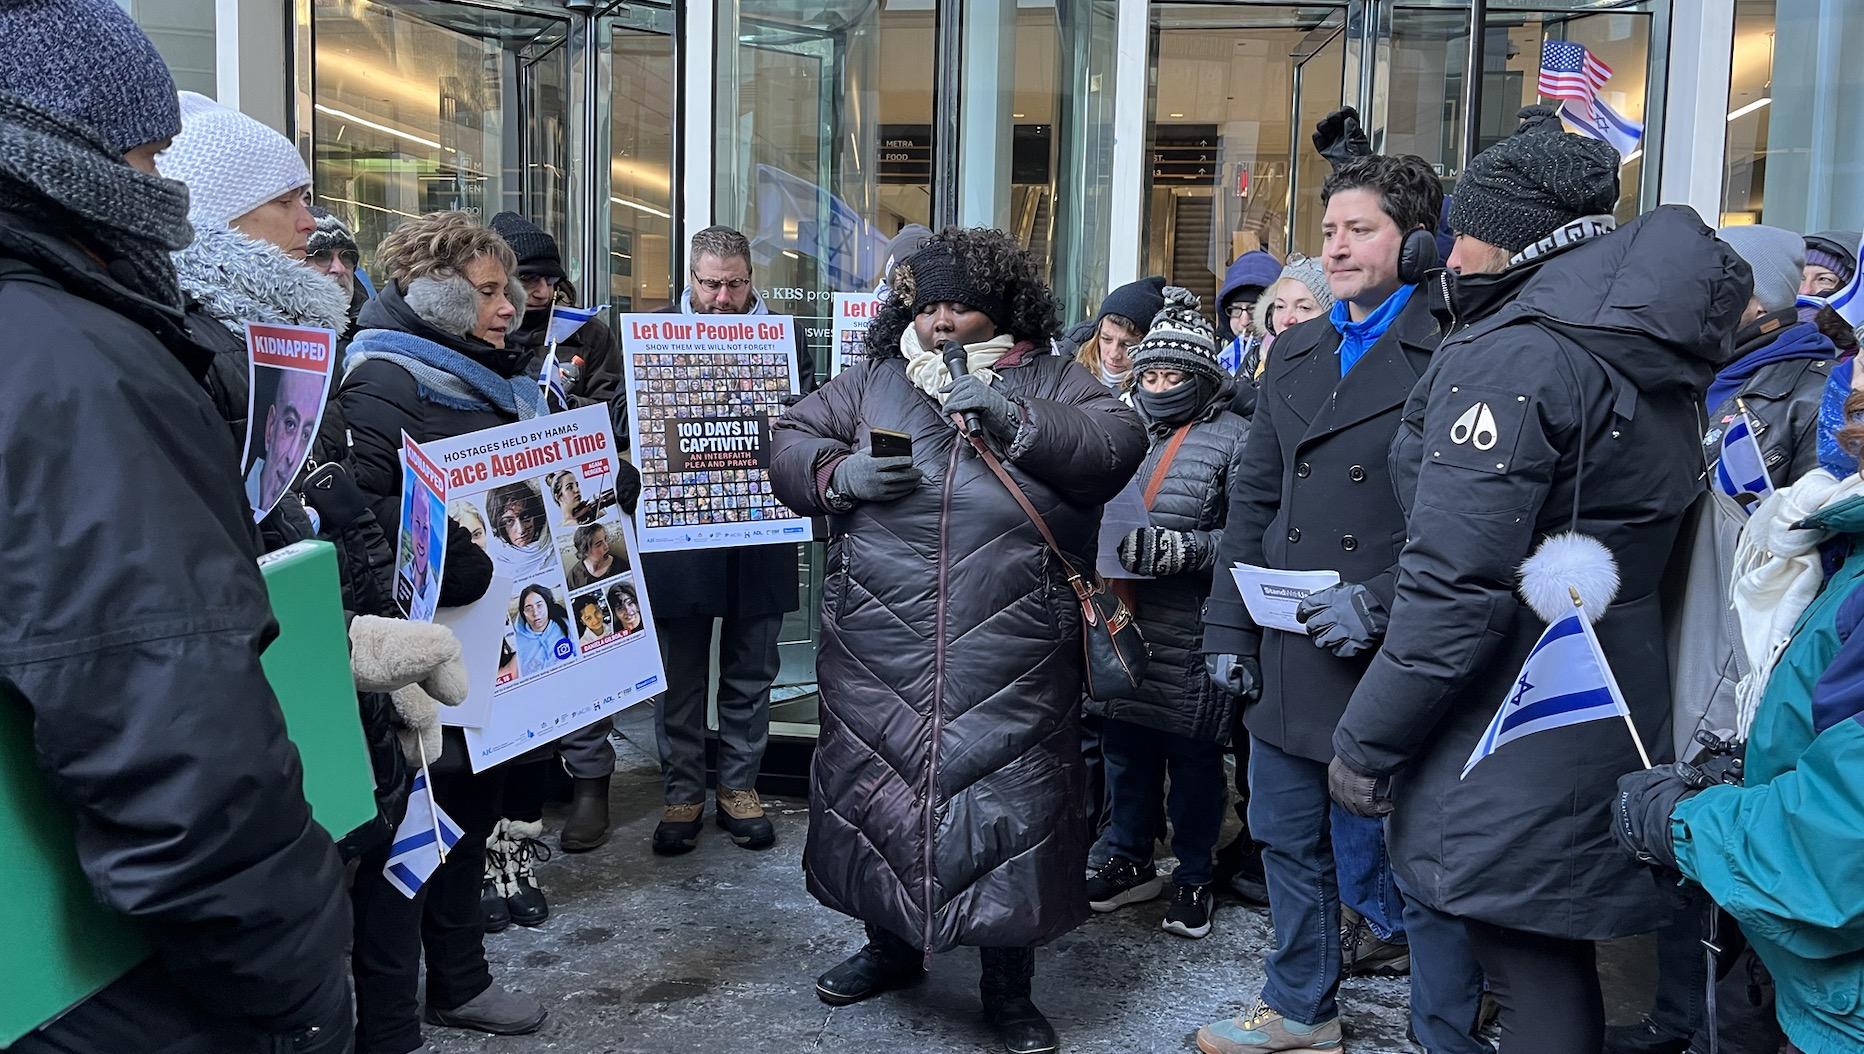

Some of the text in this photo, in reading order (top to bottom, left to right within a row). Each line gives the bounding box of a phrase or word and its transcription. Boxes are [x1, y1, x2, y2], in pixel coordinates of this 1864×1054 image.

[460, 206, 482, 215] FOO
[761, 290, 770, 299] a
[773, 288, 804, 300] KBS
[844, 300, 866, 317] Let
[632, 321, 784, 342] Let Our People Go!
[254, 336, 326, 361] KIDNAPPED
[677, 420, 759, 437] 100 DAYS IN
[444, 423, 579, 462] HOSTAGES HELD BY HAMAS
[680, 436, 760, 453] CAPTIVITY!
[490, 441, 562, 477] Against
[562, 432, 606, 458] Time
[704, 452, 751, 460] INTERFAITH
[406, 444, 444, 492] KIDNAPPED
